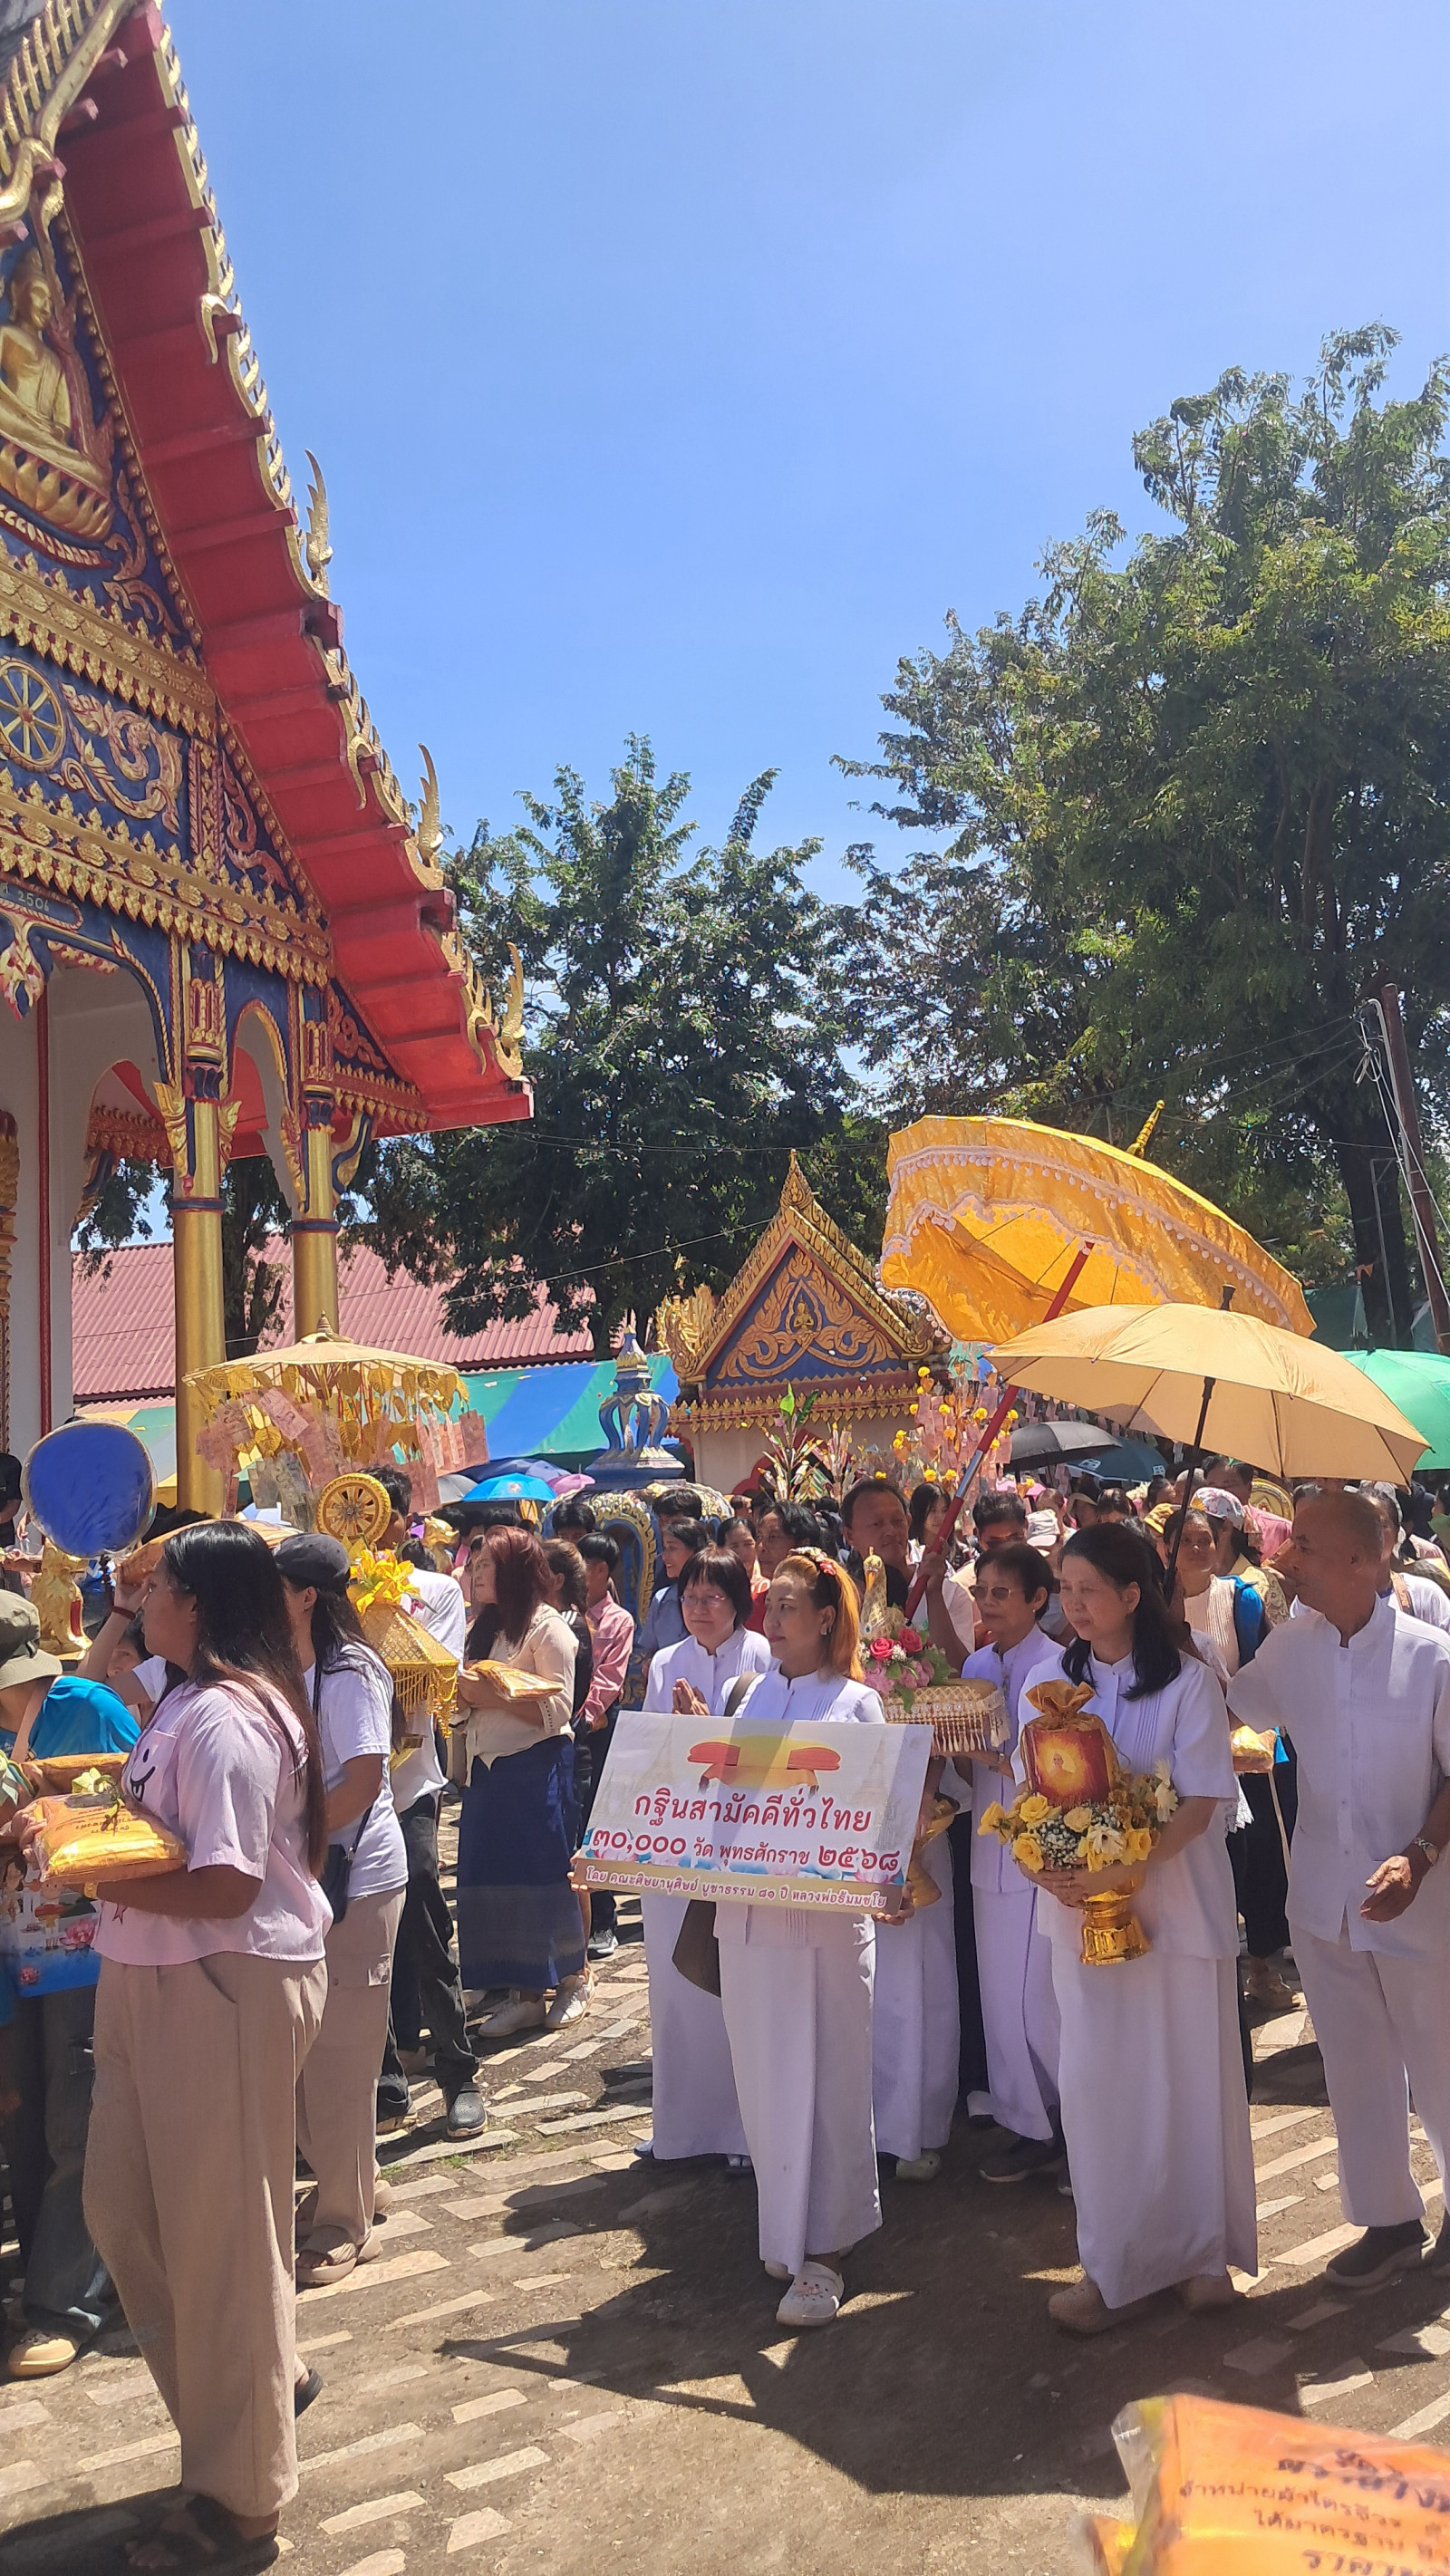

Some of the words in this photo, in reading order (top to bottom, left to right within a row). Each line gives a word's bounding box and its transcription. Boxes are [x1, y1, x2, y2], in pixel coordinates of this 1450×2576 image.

[634, 1788, 871, 1831] กฐินสามัคคีทั่วไทย
[593, 1829, 686, 1855] ๓๐,๐๐๐
[693, 1836, 713, 1857] วัด
[720, 1841, 810, 1867] พุทธศักราช
[818, 1845, 900, 1871] ๒๕๖๘
[587, 1867, 606, 1881] โดย
[611, 1872, 699, 1893] คณะศิษยานุศิษย์
[702, 1882, 755, 1897] บูชาธรรม
[759, 1888, 775, 1898] ๘๑
[779, 1886, 788, 1899] ปี
[793, 1889, 886, 1907] หลวงพ่อธัมมชโย
